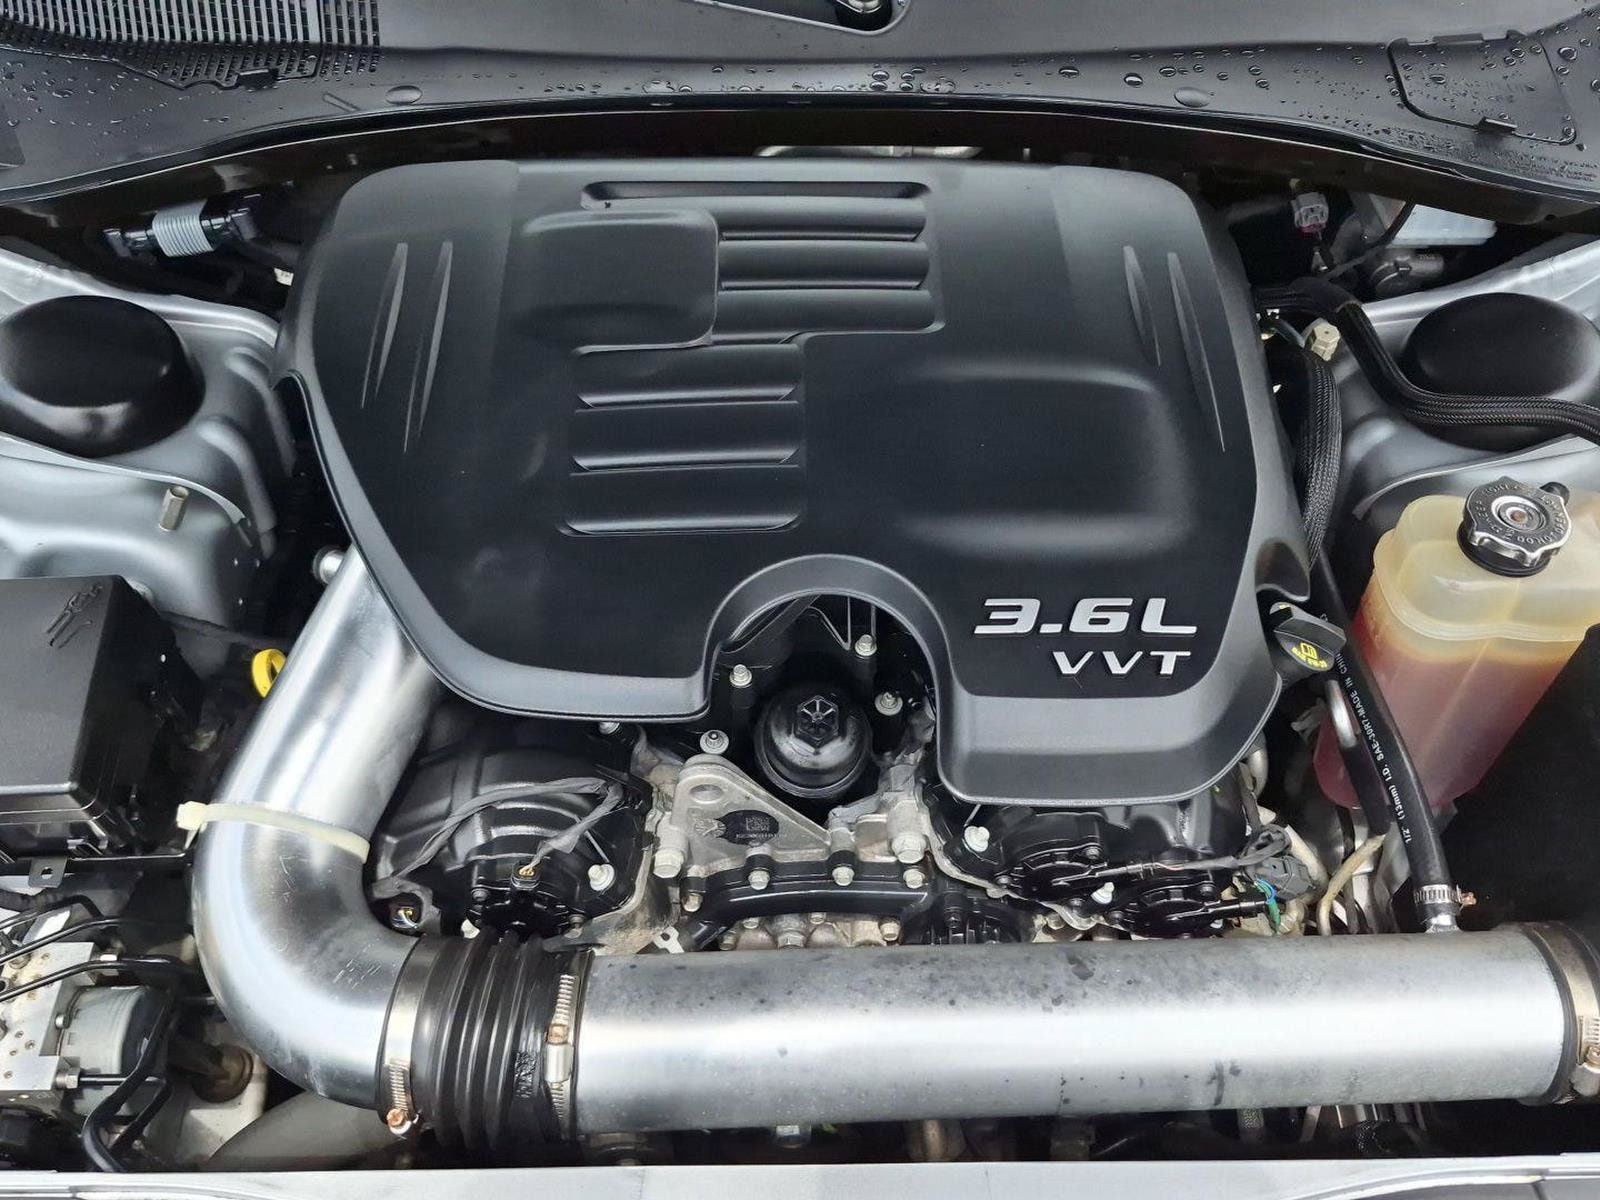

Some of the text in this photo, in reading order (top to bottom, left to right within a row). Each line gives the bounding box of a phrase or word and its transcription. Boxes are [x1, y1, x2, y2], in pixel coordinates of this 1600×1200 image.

[974, 597, 1198, 635] 3.6L
[1052, 650, 1192, 676] VVT
[1344, 676, 1354, 688] IN
[1382, 764, 1392, 781] I.D.
[1388, 784, 1406, 820] (13mm)
